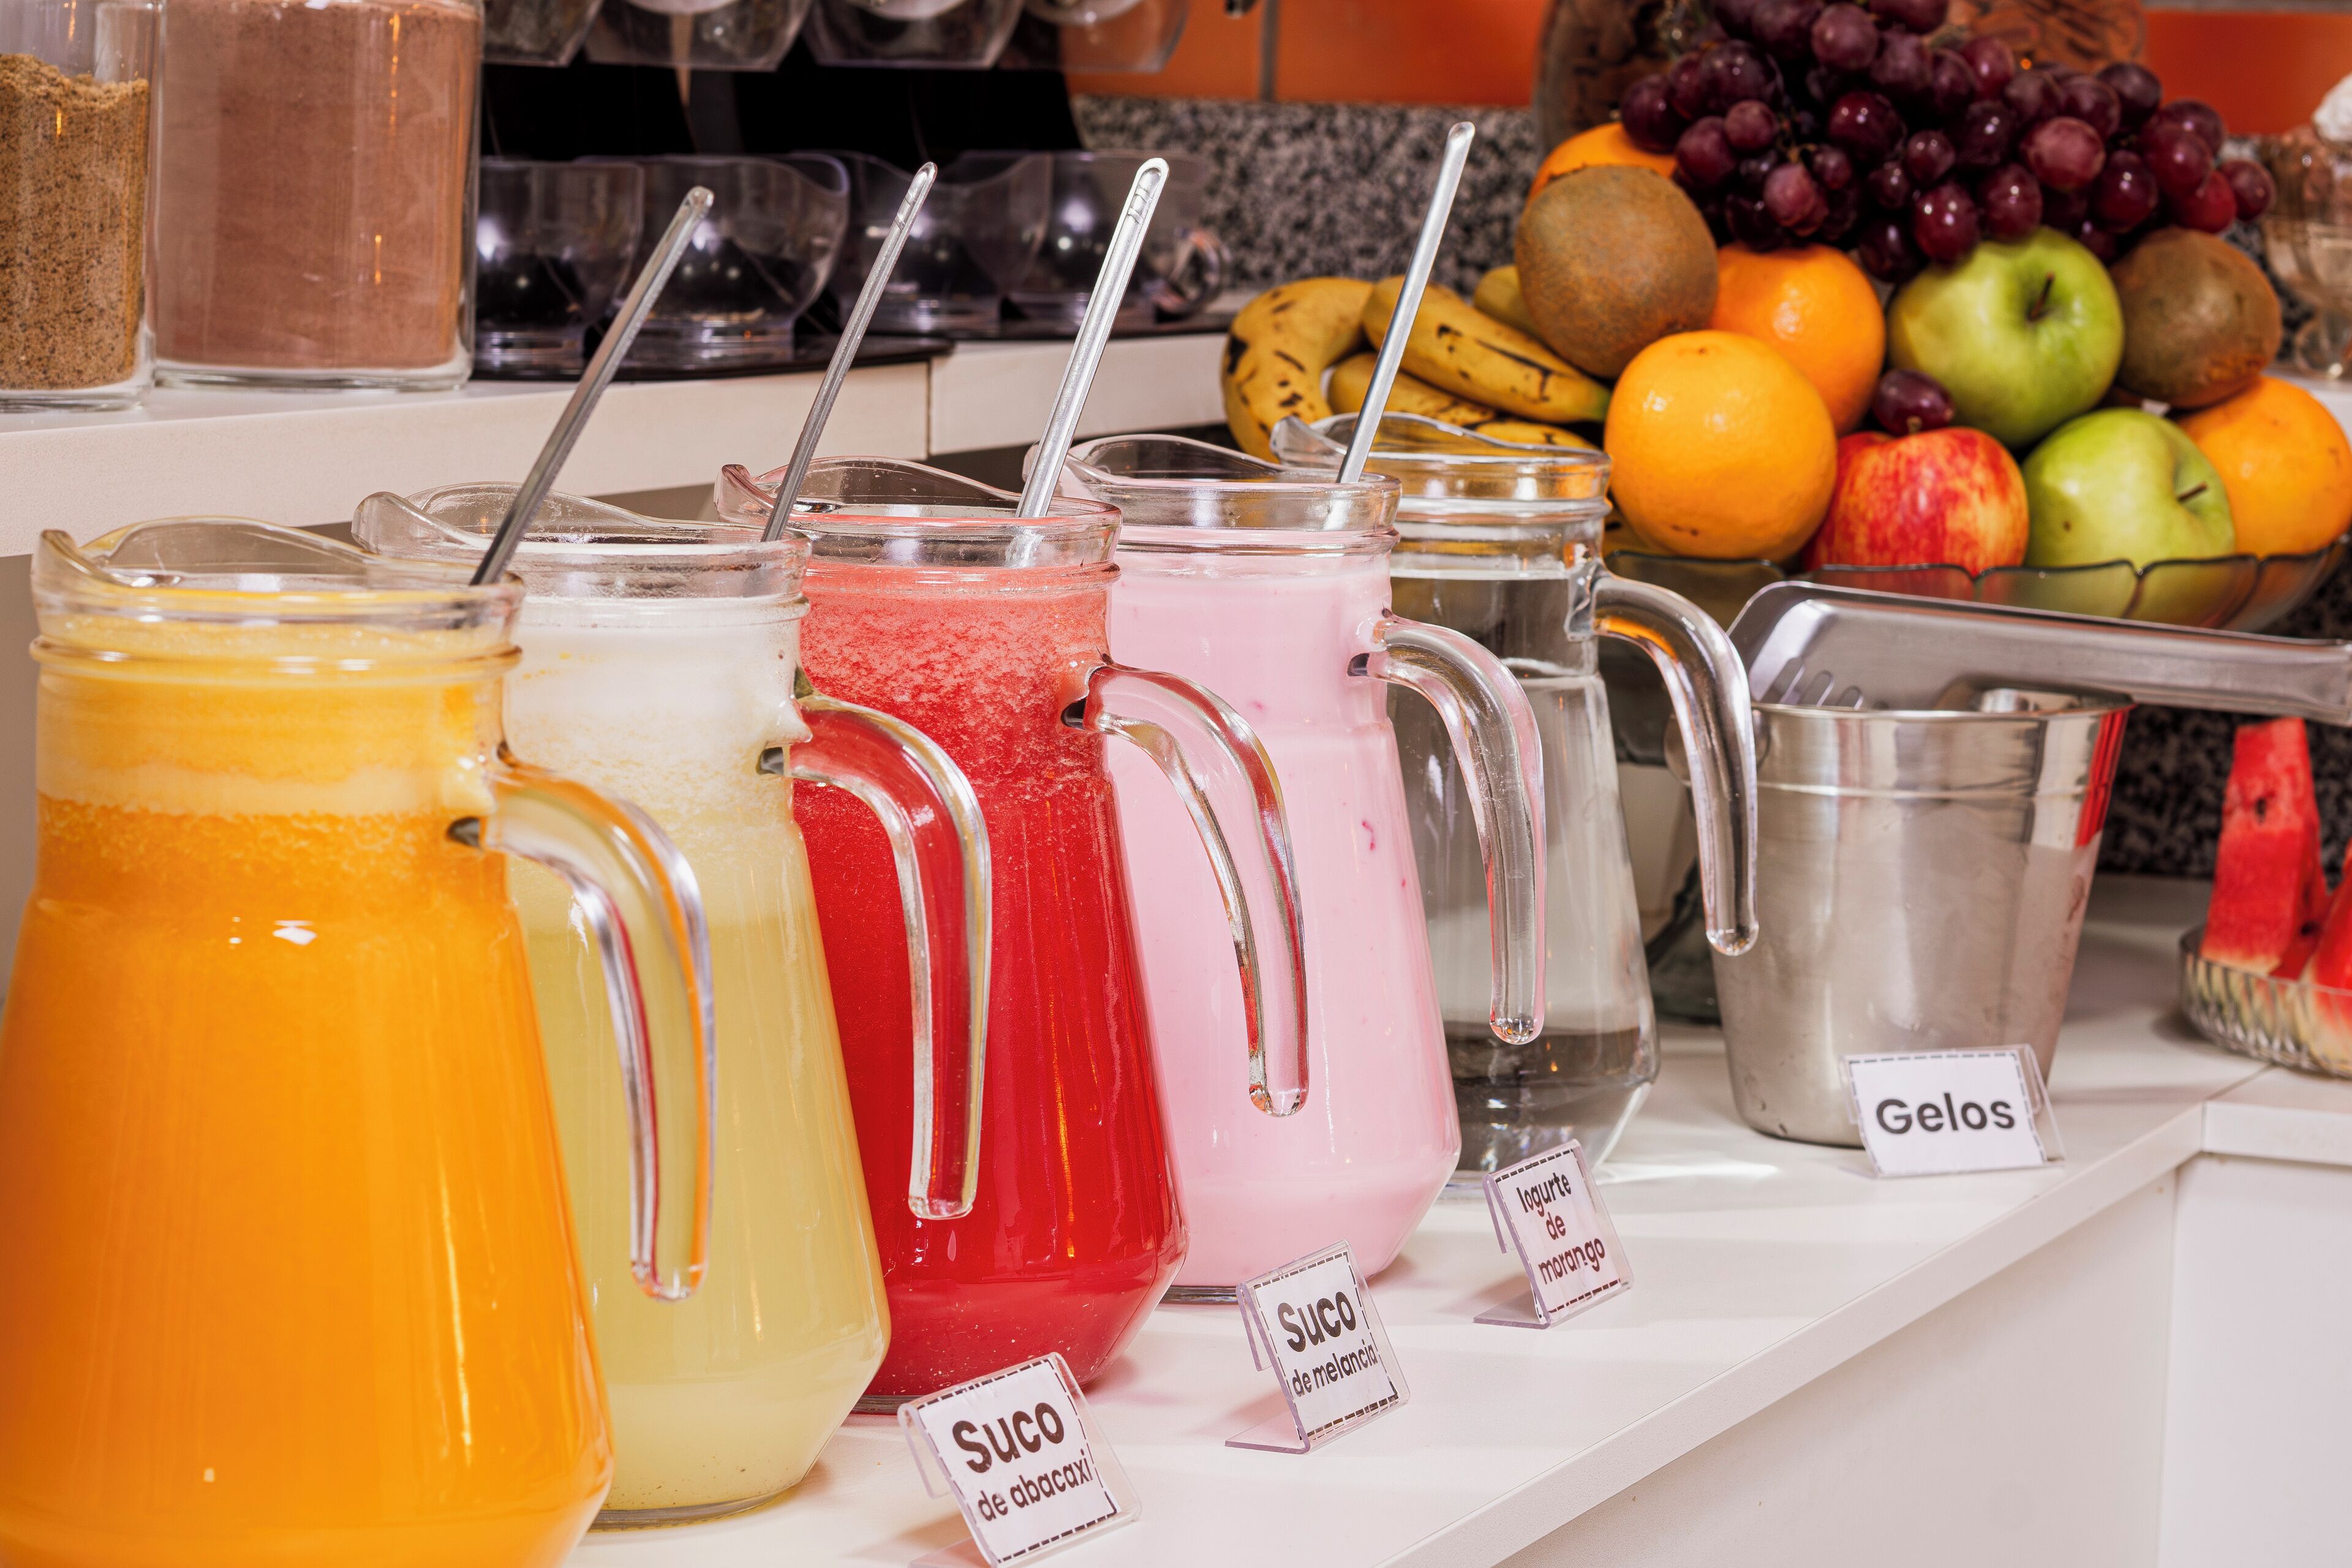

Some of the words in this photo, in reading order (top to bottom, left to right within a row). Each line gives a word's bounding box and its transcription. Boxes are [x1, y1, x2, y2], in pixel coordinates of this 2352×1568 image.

[1876, 1092, 2015, 1134] Gelos
[1516, 1172, 1572, 1217] Iogurte
[1545, 1212, 1566, 1240] de
[1538, 1238, 1605, 1285] morango
[1277, 1291, 1356, 1352] Suco
[1292, 1369, 1312, 1397] de
[1312, 1338, 1378, 1389] melancia
[952, 1402, 1064, 1473] Suco
[978, 1490, 1009, 1521] de
[1010, 1449, 1093, 1509] abacaxi
